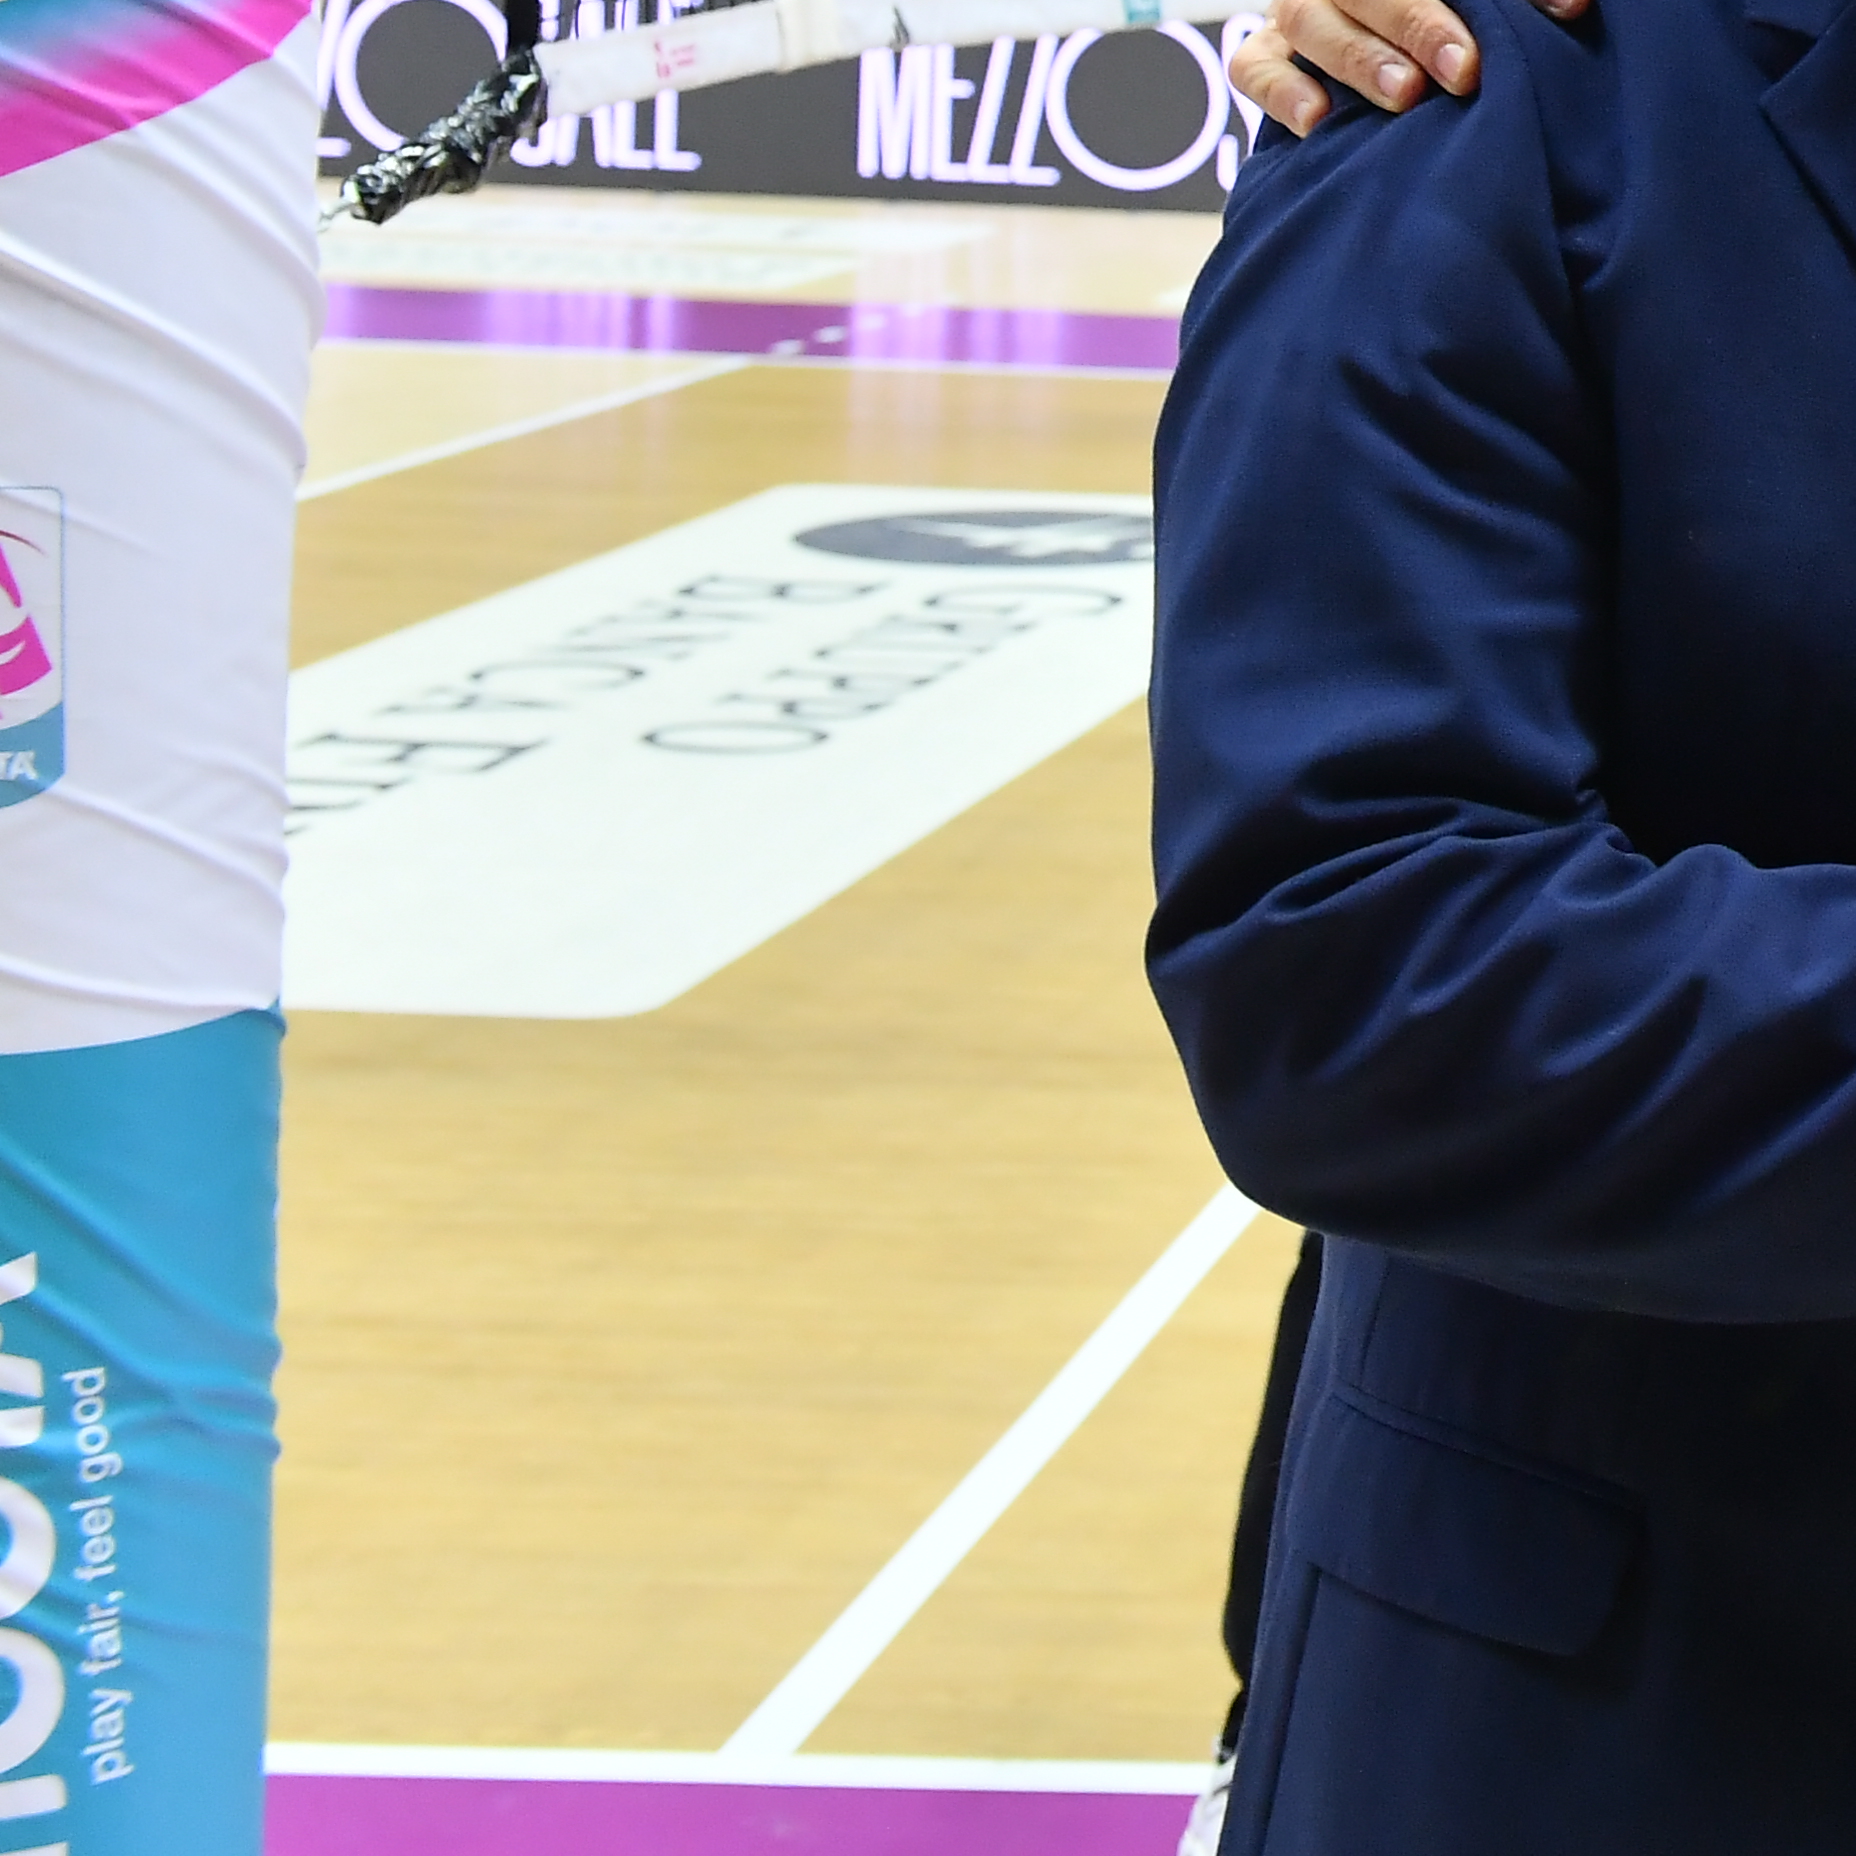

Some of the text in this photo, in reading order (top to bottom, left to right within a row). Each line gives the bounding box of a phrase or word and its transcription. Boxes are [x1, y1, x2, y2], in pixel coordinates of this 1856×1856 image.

[59, 1365, 134, 1786] play fair, feel good
